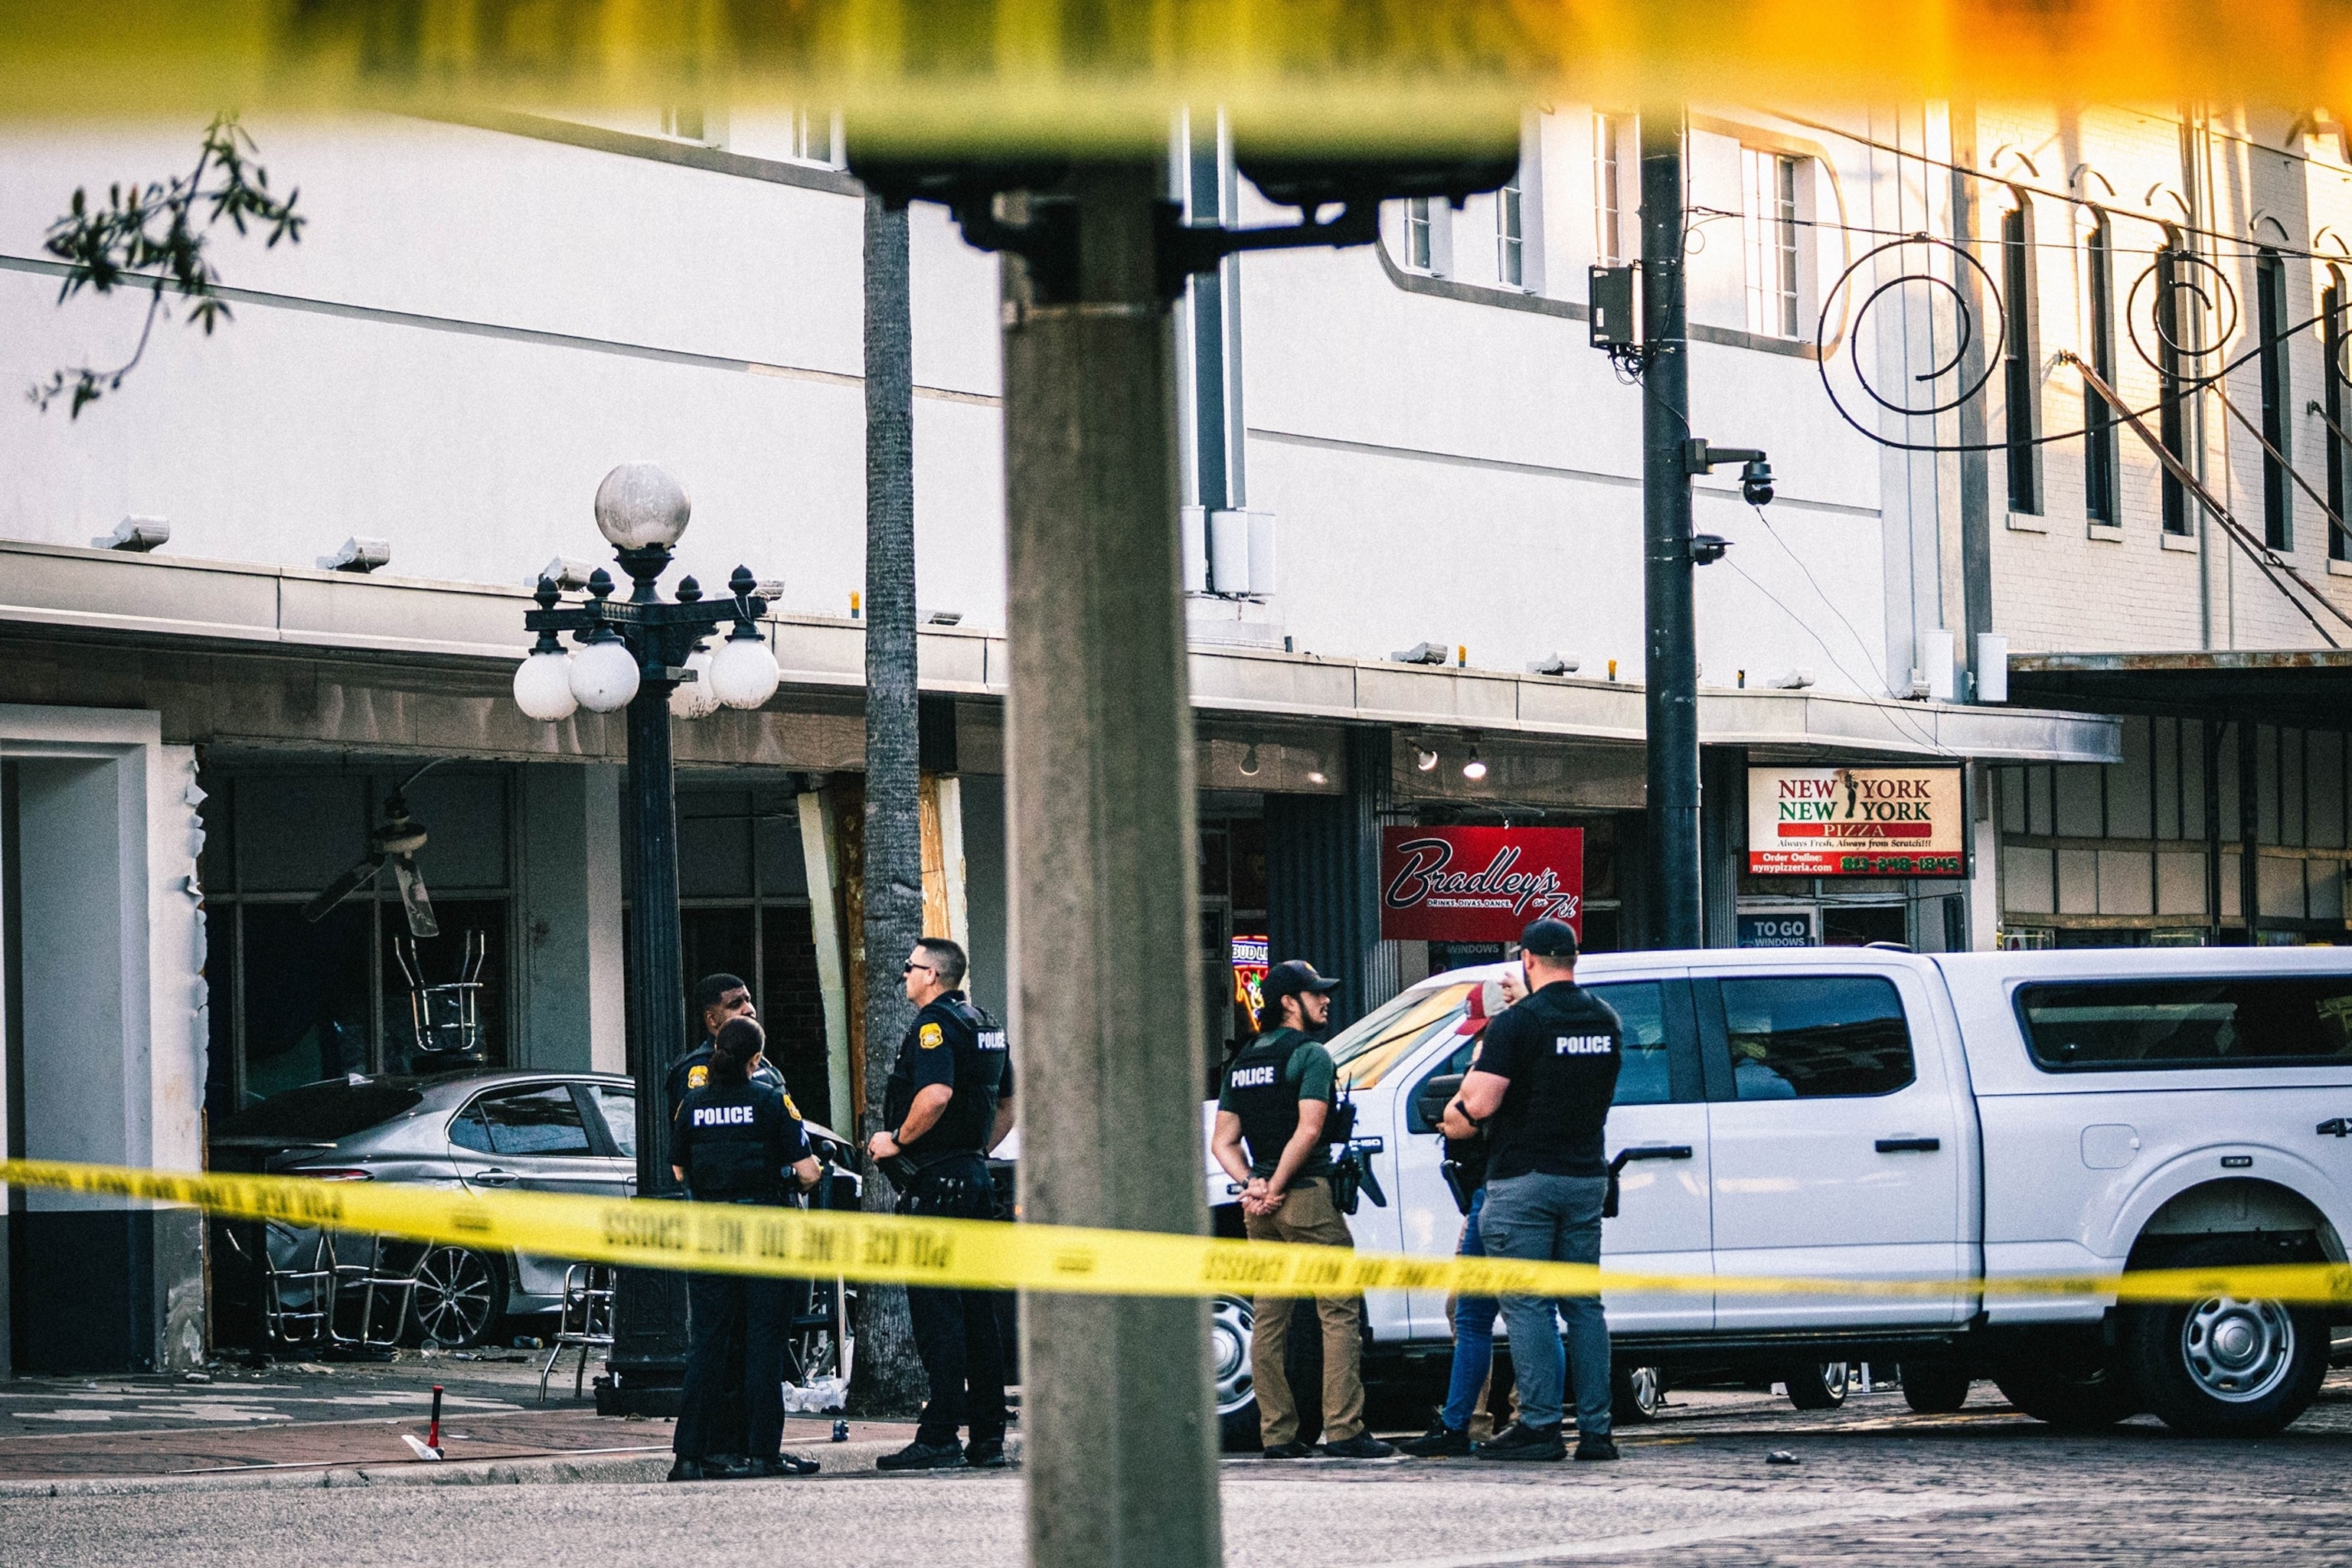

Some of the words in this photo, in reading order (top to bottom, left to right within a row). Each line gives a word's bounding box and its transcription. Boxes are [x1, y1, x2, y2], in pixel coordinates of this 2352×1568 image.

[1779, 779, 1837, 798] NEW
[1860, 779, 1931, 798] YORK
[1779, 802, 1837, 820] NEW
[1860, 802, 1931, 820] YORK
[1823, 824, 1885, 837] PIZZA
[1778, 839, 1808, 850] Always
[1810, 839, 1834, 848] Fresh,
[1837, 838, 1866, 850] Always
[1867, 839, 1889, 850] from
[1762, 853, 1788, 861] Order
[1791, 853, 1823, 861] Online:
[1841, 856, 1959, 871] 813-248-1845
[1753, 863, 1832, 873] nynypizzeria.com
[1385, 838, 1560, 916] Bradley's
[1458, 899, 1483, 907] DIVAS.
[1533, 898, 1548, 906] on
[1538, 893, 1578, 920] 7th
[1754, 922, 1777, 936] TO
[1780, 921, 1805, 936] GO
[1449, 944, 1499, 953] WINDOWS
[1755, 938, 1805, 946] WINDOWS
[1557, 1036, 1612, 1054] POLICE
[1231, 1066, 1274, 1087] POLICE
[694, 1106, 754, 1126] POLICE
